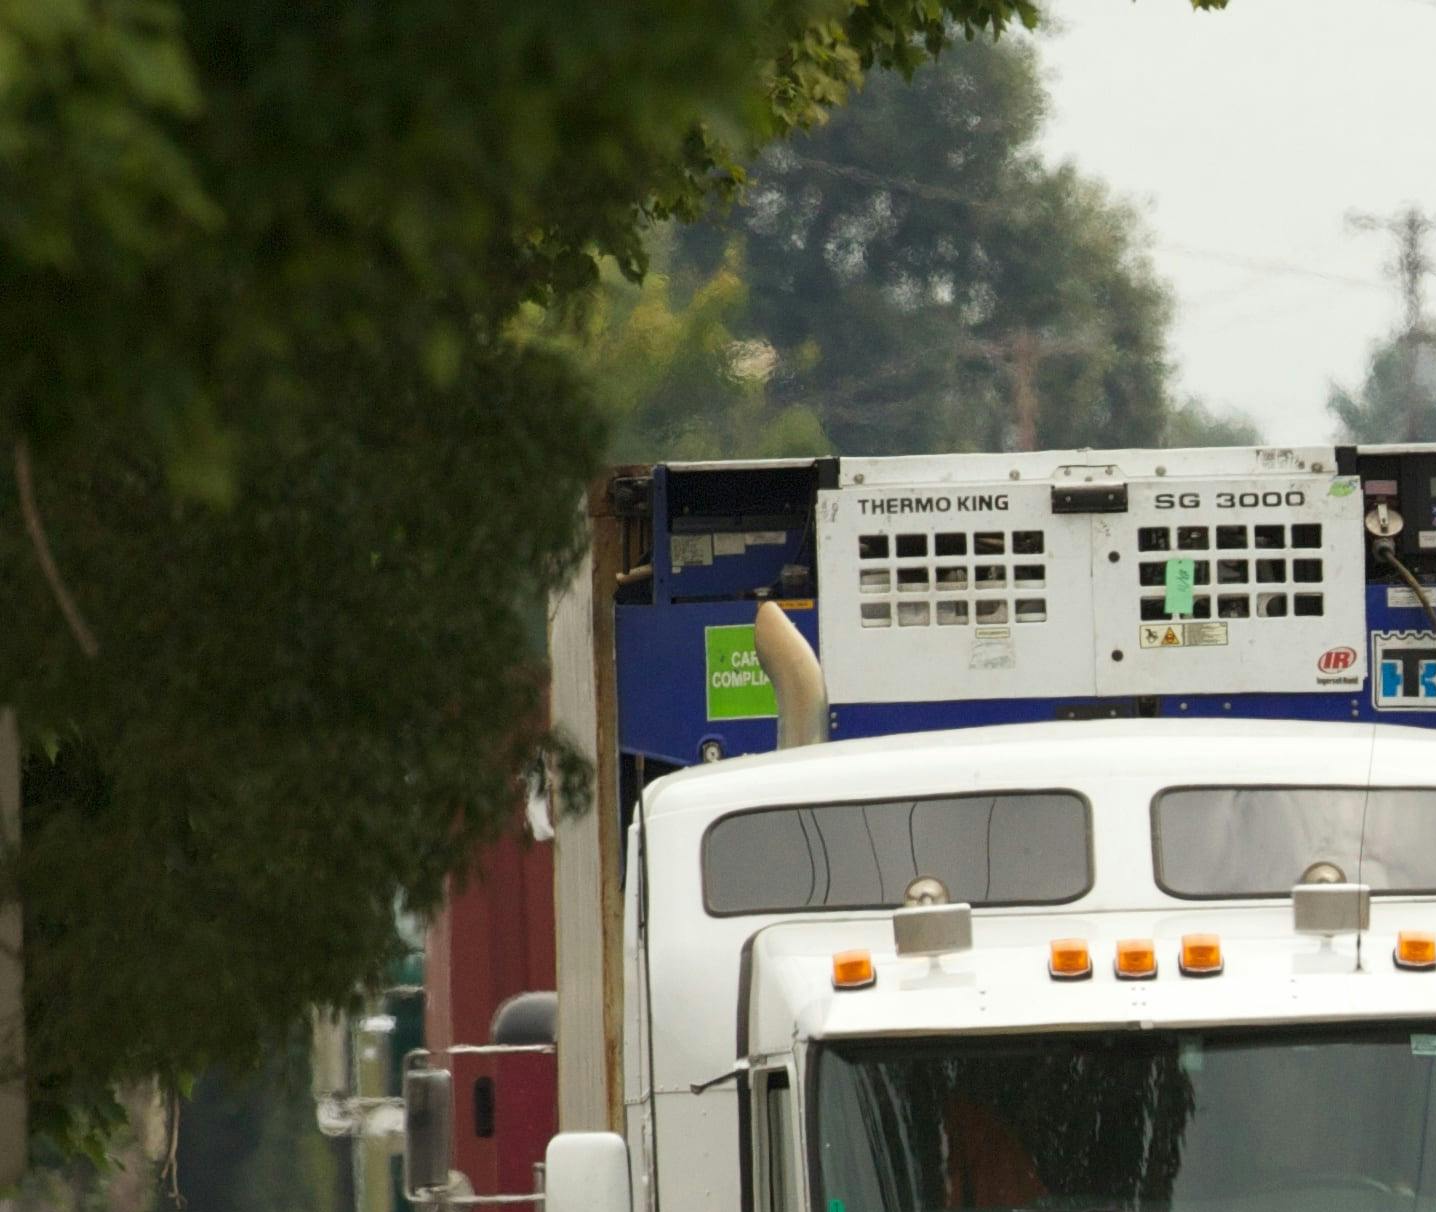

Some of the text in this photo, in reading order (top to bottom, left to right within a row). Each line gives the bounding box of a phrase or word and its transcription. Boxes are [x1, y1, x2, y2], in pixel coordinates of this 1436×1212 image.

[857, 496, 952, 515] THERMO
[956, 494, 1010, 512] KING
[1155, 491, 1306, 510] SG 3000
[731, 650, 760, 668] CAR
[1323, 651, 1351, 669] IR
